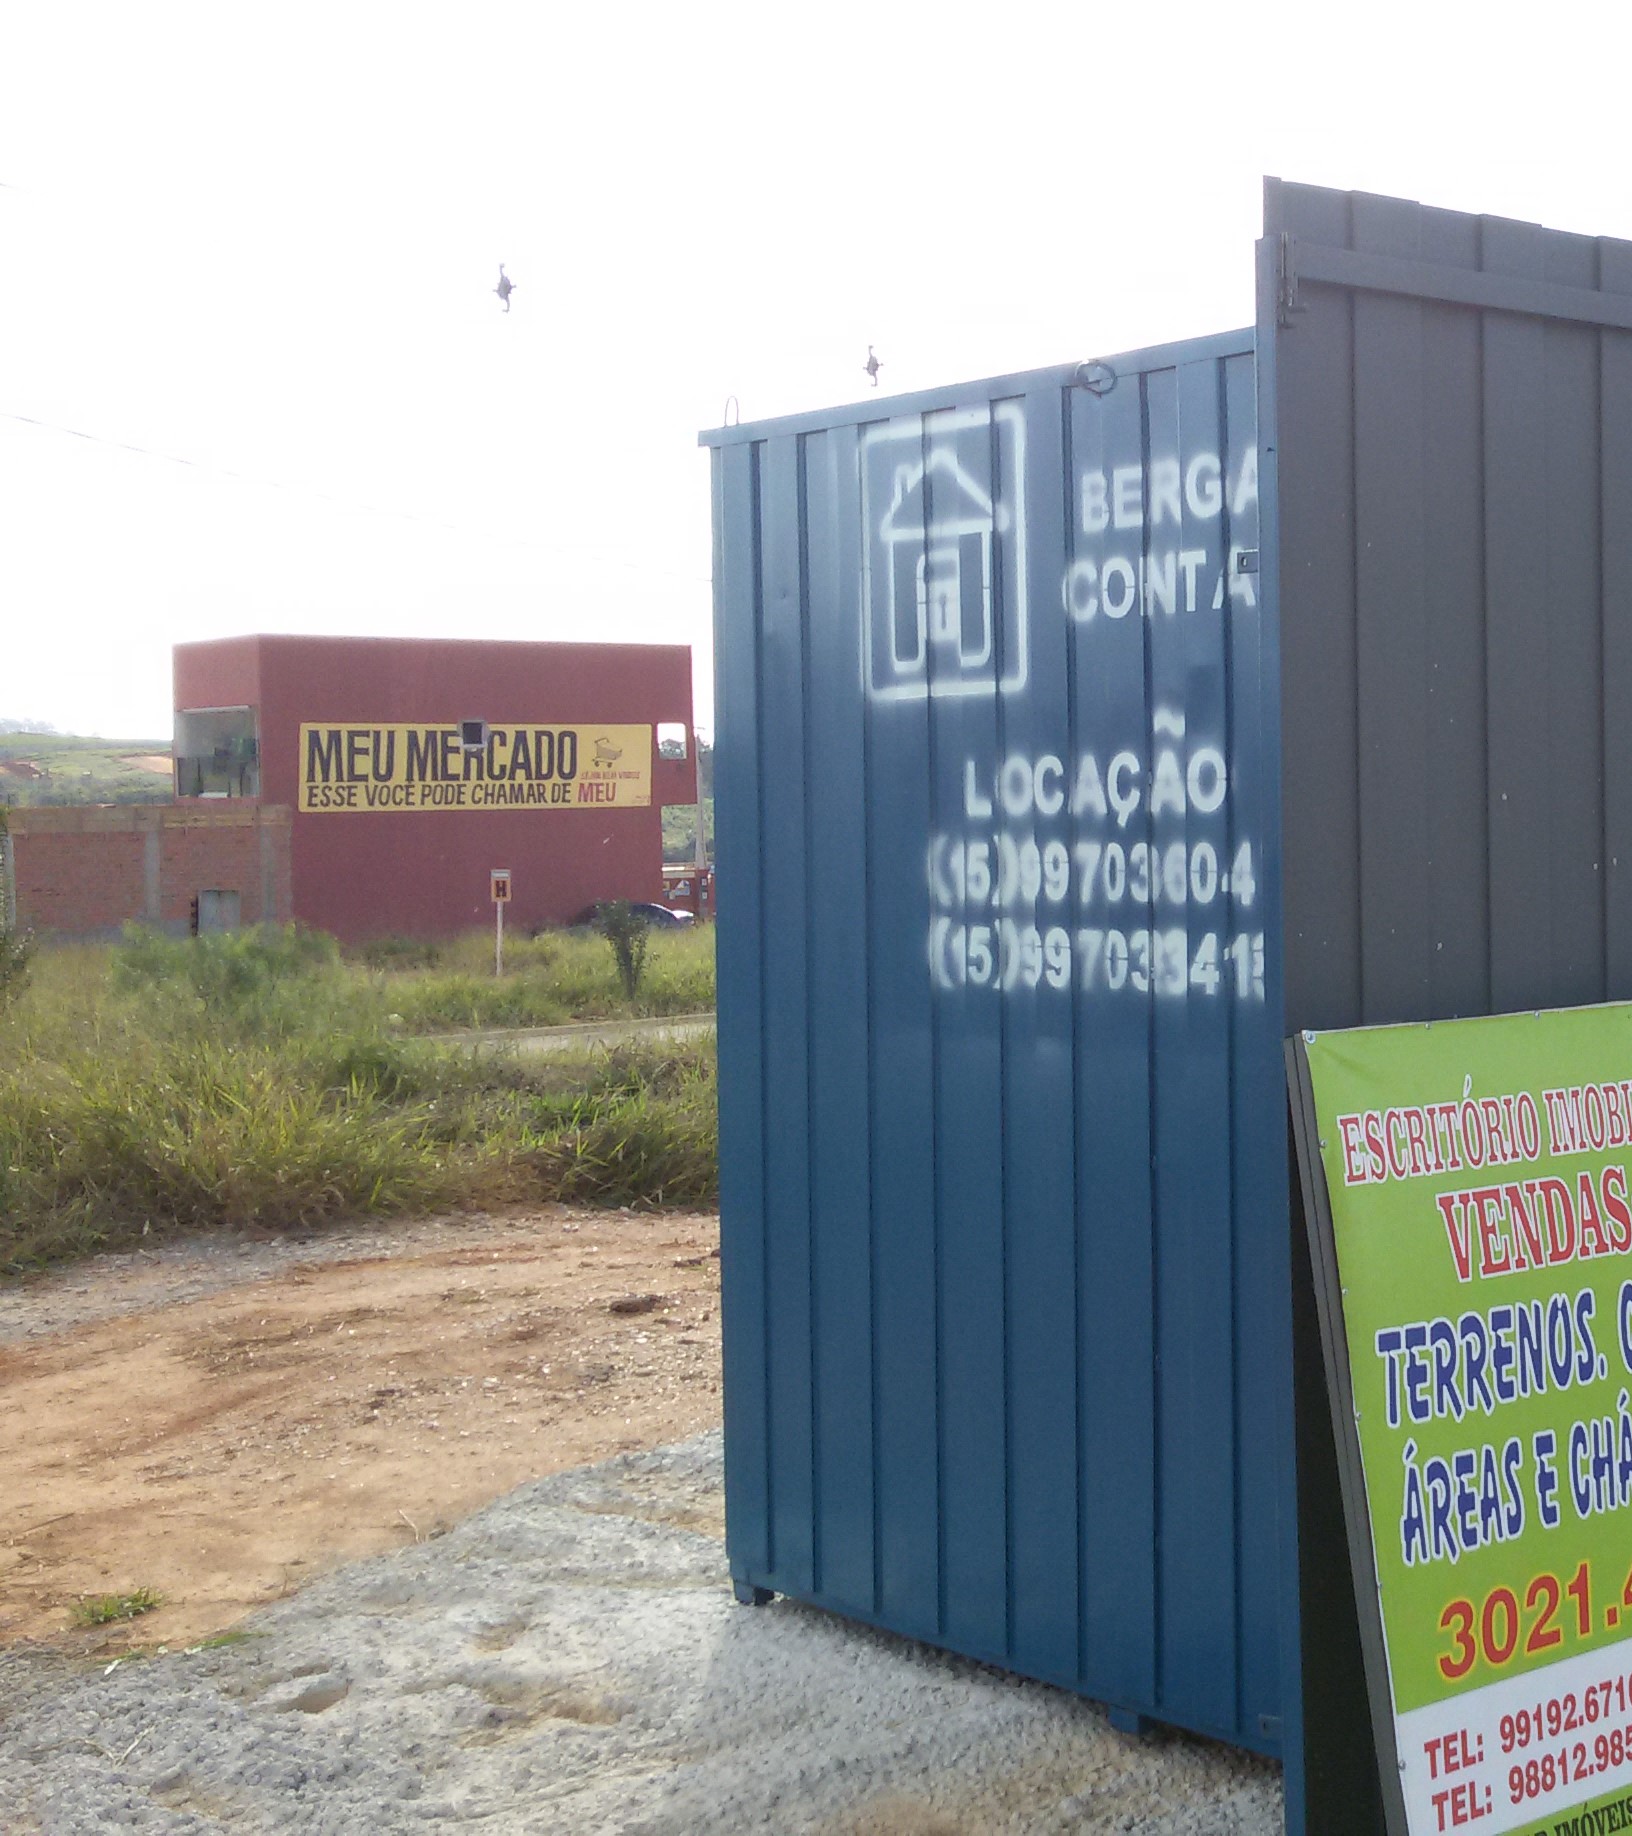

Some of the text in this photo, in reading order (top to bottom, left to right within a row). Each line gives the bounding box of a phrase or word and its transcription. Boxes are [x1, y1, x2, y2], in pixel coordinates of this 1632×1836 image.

[306, 730, 578, 782] MEU MERCADO
[964, 706, 1228, 827] LOCAÇÃO
[307, 784, 358, 807] ESSE
[420, 783, 467, 806] PODE
[470, 782, 548, 805] CHAMAR
[551, 782, 571, 803] DE
[578, 782, 616, 803] MEU
[1339, 1074, 1542, 1186] ESCRITÓRIO
[1401, 1437, 1525, 1566] ÁREAS
[1533, 1430, 1560, 1529] E
[1424, 1728, 1484, 1780] TEL:
[1431, 1781, 1493, 1832] TEL:
